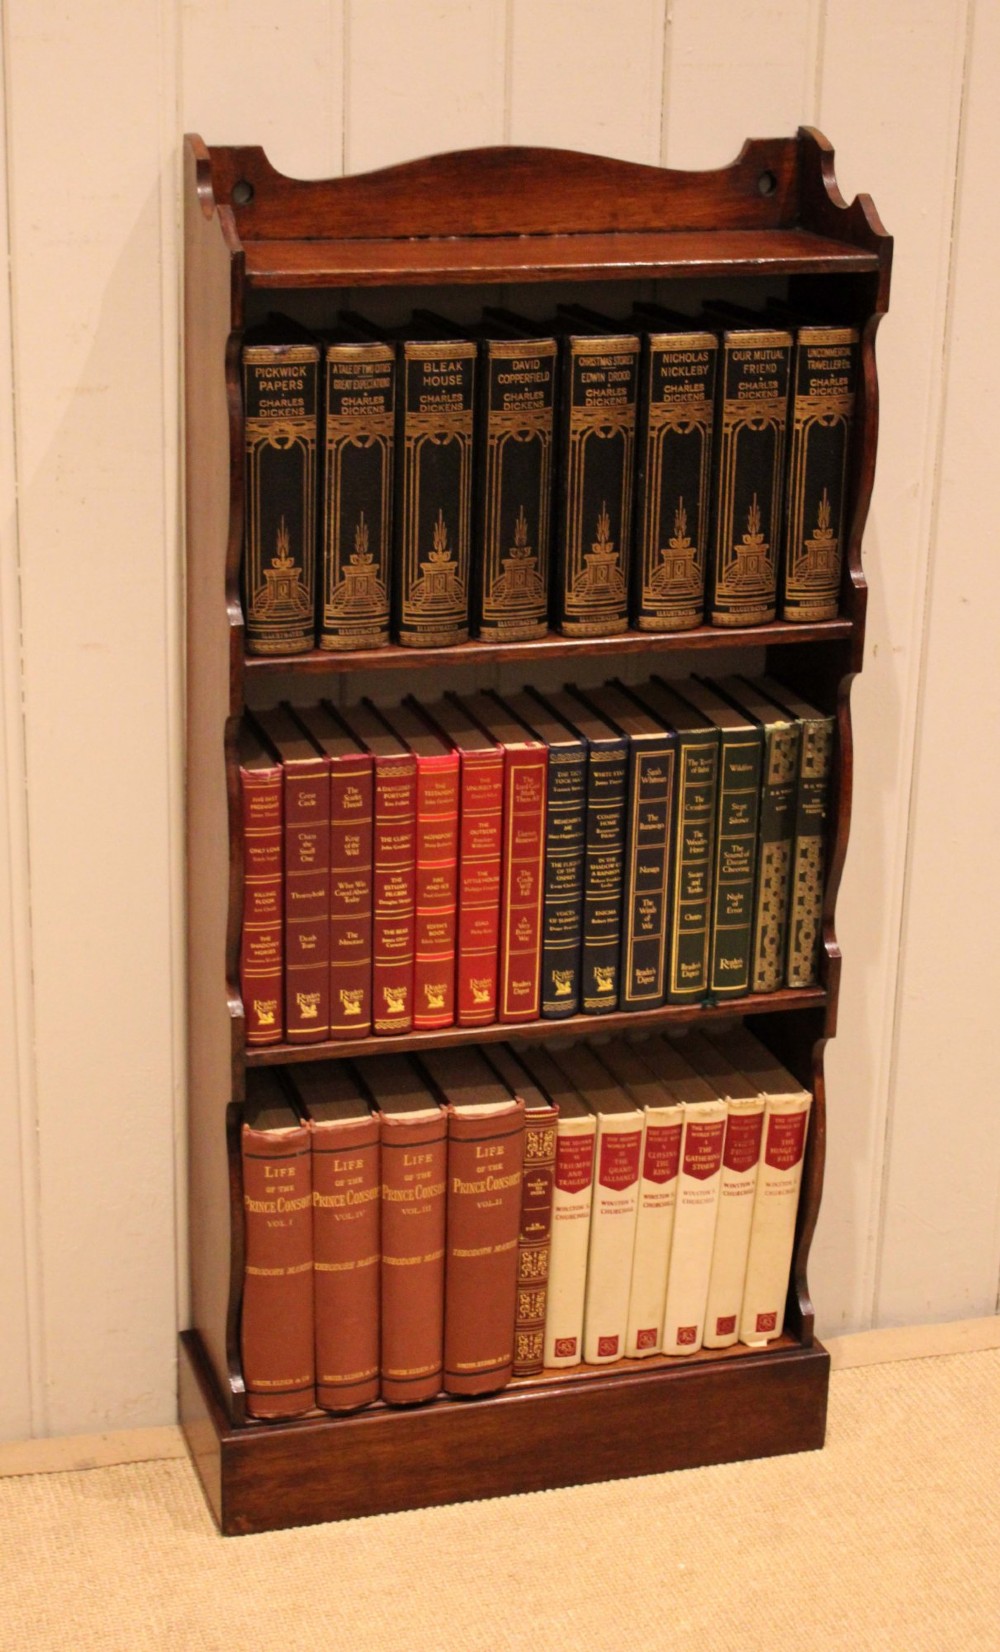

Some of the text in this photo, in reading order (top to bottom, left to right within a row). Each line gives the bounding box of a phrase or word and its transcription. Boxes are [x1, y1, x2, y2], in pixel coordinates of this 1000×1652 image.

[662, 352, 709, 364] NICHOLAS
[732, 350, 784, 360] OUR MUTUAL
[423, 361, 463, 372] BLEAK
[512, 360, 540, 370] DAVID
[743, 364, 777, 374] FRIEND
[255, 366, 306, 378] PICKWICK
[661, 365, 709, 377] NICKLEBY
[423, 375, 463, 386] HOUSE
[498, 371, 550, 384] COPPERFIELD
[581, 370, 631, 383] EDWIN DROOD
[260, 380, 304, 391] PAPERS
[738, 380, 778, 390] CHARLES
[810, 377, 848, 387] CHARLES
[585, 387, 627, 397] CHARLES
[664, 383, 705, 393] CHARLES
[810, 386, 848, 395] DICKENS
[420, 394, 463, 403] CHARLES
[503, 391, 544, 401] CHARLES
[664, 393, 706, 402] DICKENS
[738, 390, 778, 399] DICKENS
[260, 398, 304, 407] CHARLES
[341, 396, 384, 405] CHARLES
[503, 401, 544, 410] DICKENS
[585, 397, 628, 406] DICKENS
[260, 408, 305, 417] DICKENS
[341, 406, 385, 414] DICKENS
[420, 403, 463, 412] DICKENS
[476, 1146, 504, 1158] LIFE
[403, 1154, 433, 1166] LIFE
[334, 1160, 364, 1172] LIFE
[476, 1163, 503, 1173] OF THE
[264, 1166, 296, 1178] LIFE
[416, 1171, 432, 1179] THE
[347, 1177, 363, 1185] THE
[453, 1172, 521, 1194] PRINCE CONSORT
[278, 1184, 295, 1192] THE
[382, 1184, 415, 1201] PRINCE
[244, 1195, 277, 1213] PRINCE
[313, 1192, 346, 1207] PRINCE
